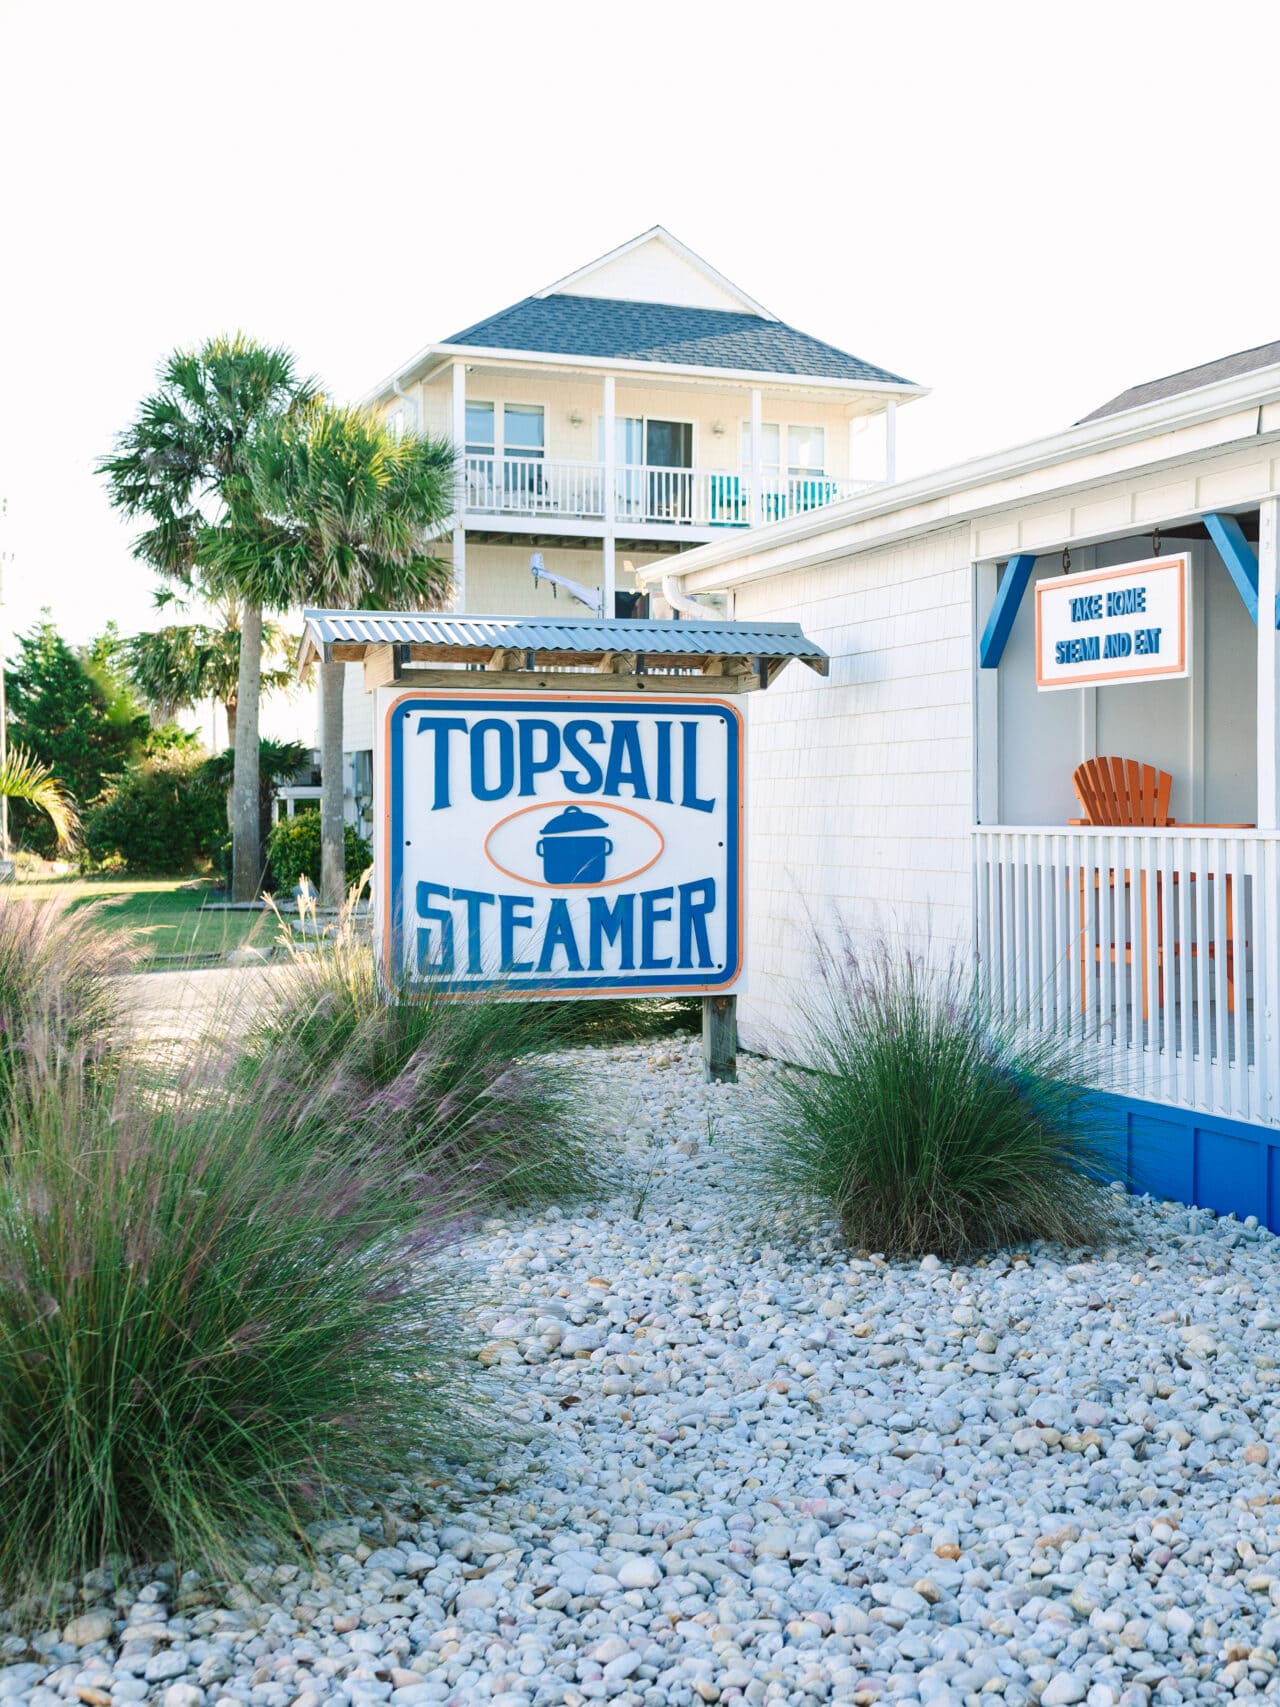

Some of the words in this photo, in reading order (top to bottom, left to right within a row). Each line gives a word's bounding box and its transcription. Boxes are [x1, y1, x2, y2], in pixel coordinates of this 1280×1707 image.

[1069, 594, 1103, 622] TAKE
[1106, 587, 1147, 617] HOME
[1055, 636, 1100, 664] STEAM
[1103, 633, 1132, 659] AND
[1134, 628, 1162, 655] EAT
[416, 717, 717, 814] TOPSAIL
[415, 876, 724, 975] STEAMER
